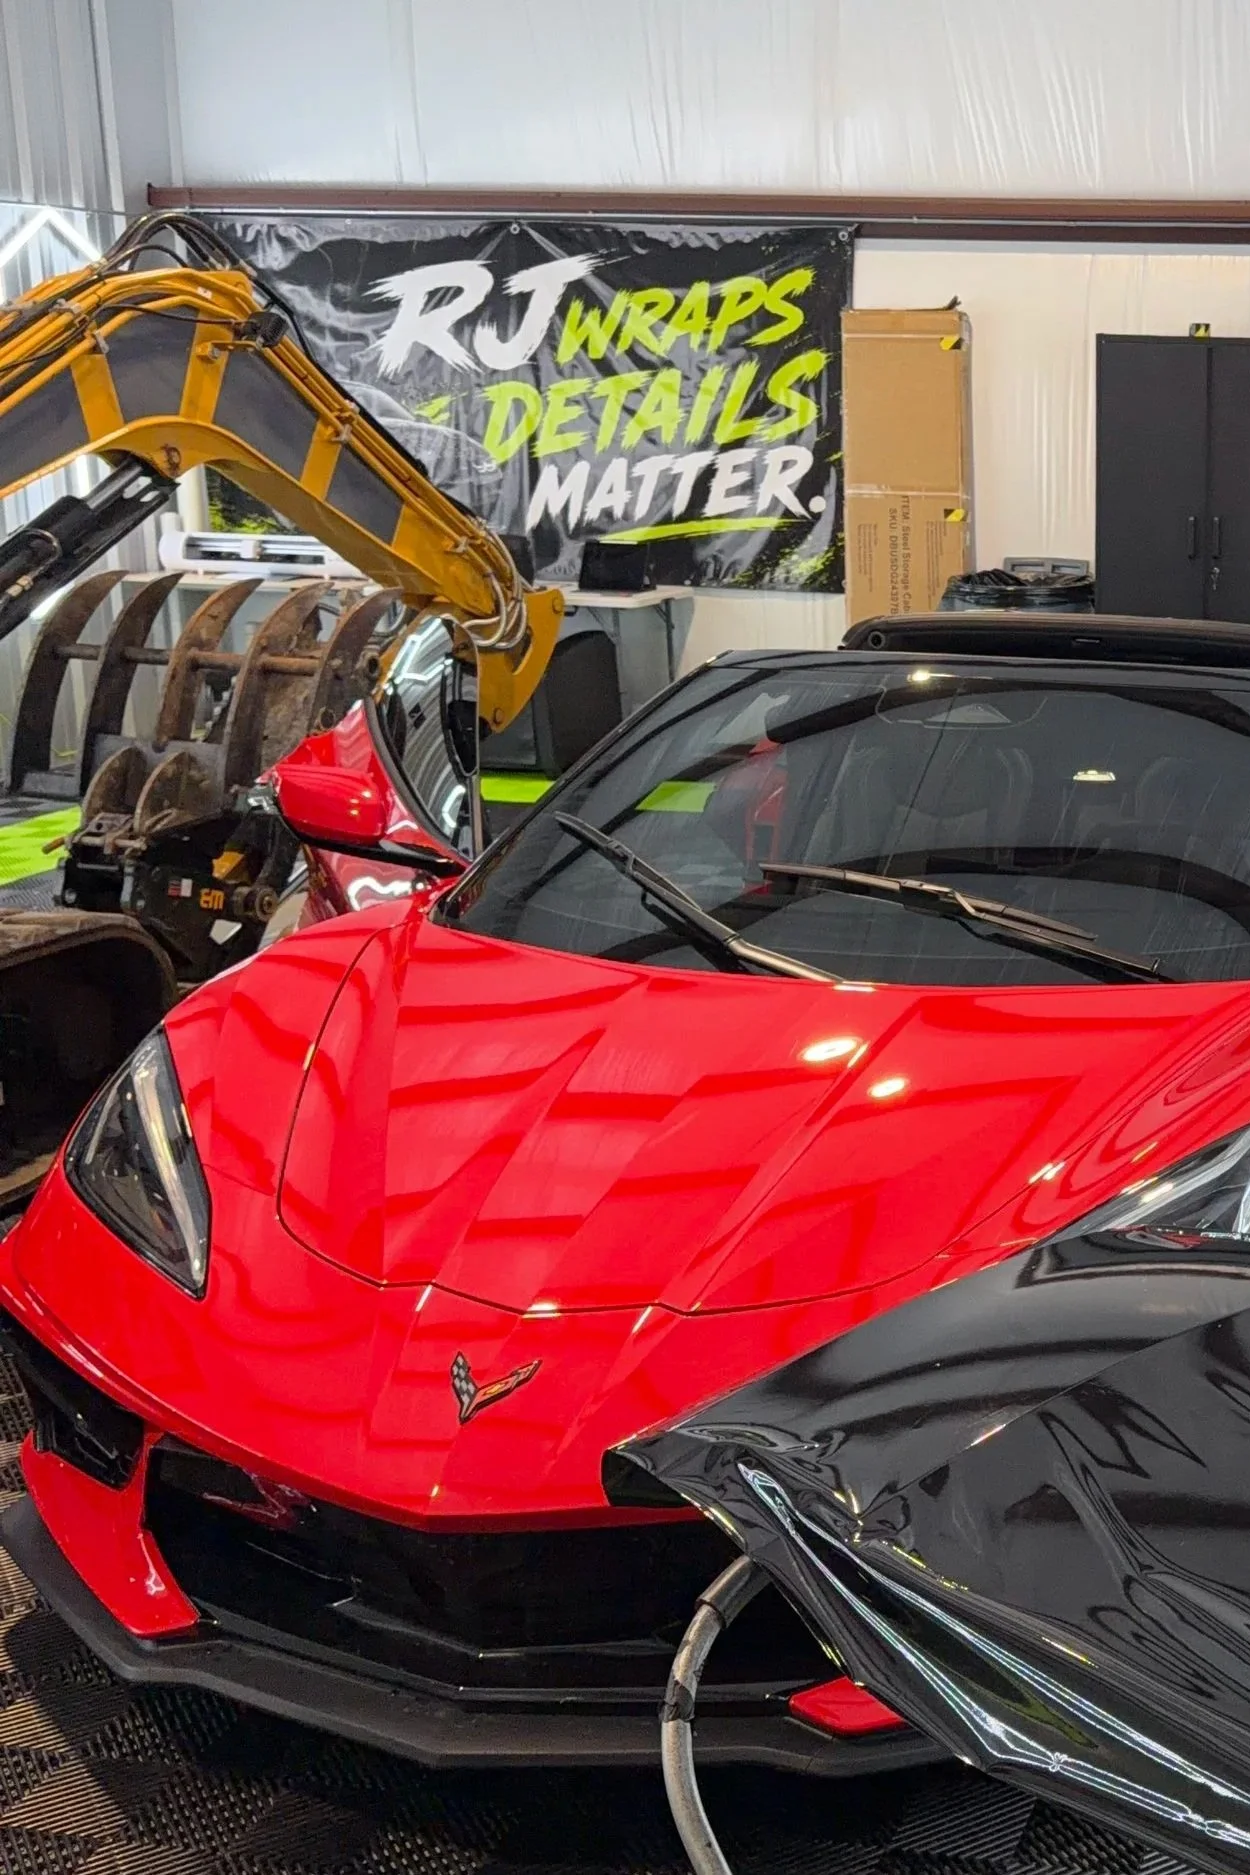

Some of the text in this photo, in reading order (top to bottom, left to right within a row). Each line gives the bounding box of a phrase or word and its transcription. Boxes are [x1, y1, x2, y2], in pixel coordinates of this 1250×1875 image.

[366, 250, 815, 377] RJ WRAPS
[481, 348, 829, 466] DETAILS
[525, 445, 826, 532] MATTER.
[901, 552, 912, 590] Storage
[902, 526, 911, 550] Steel
